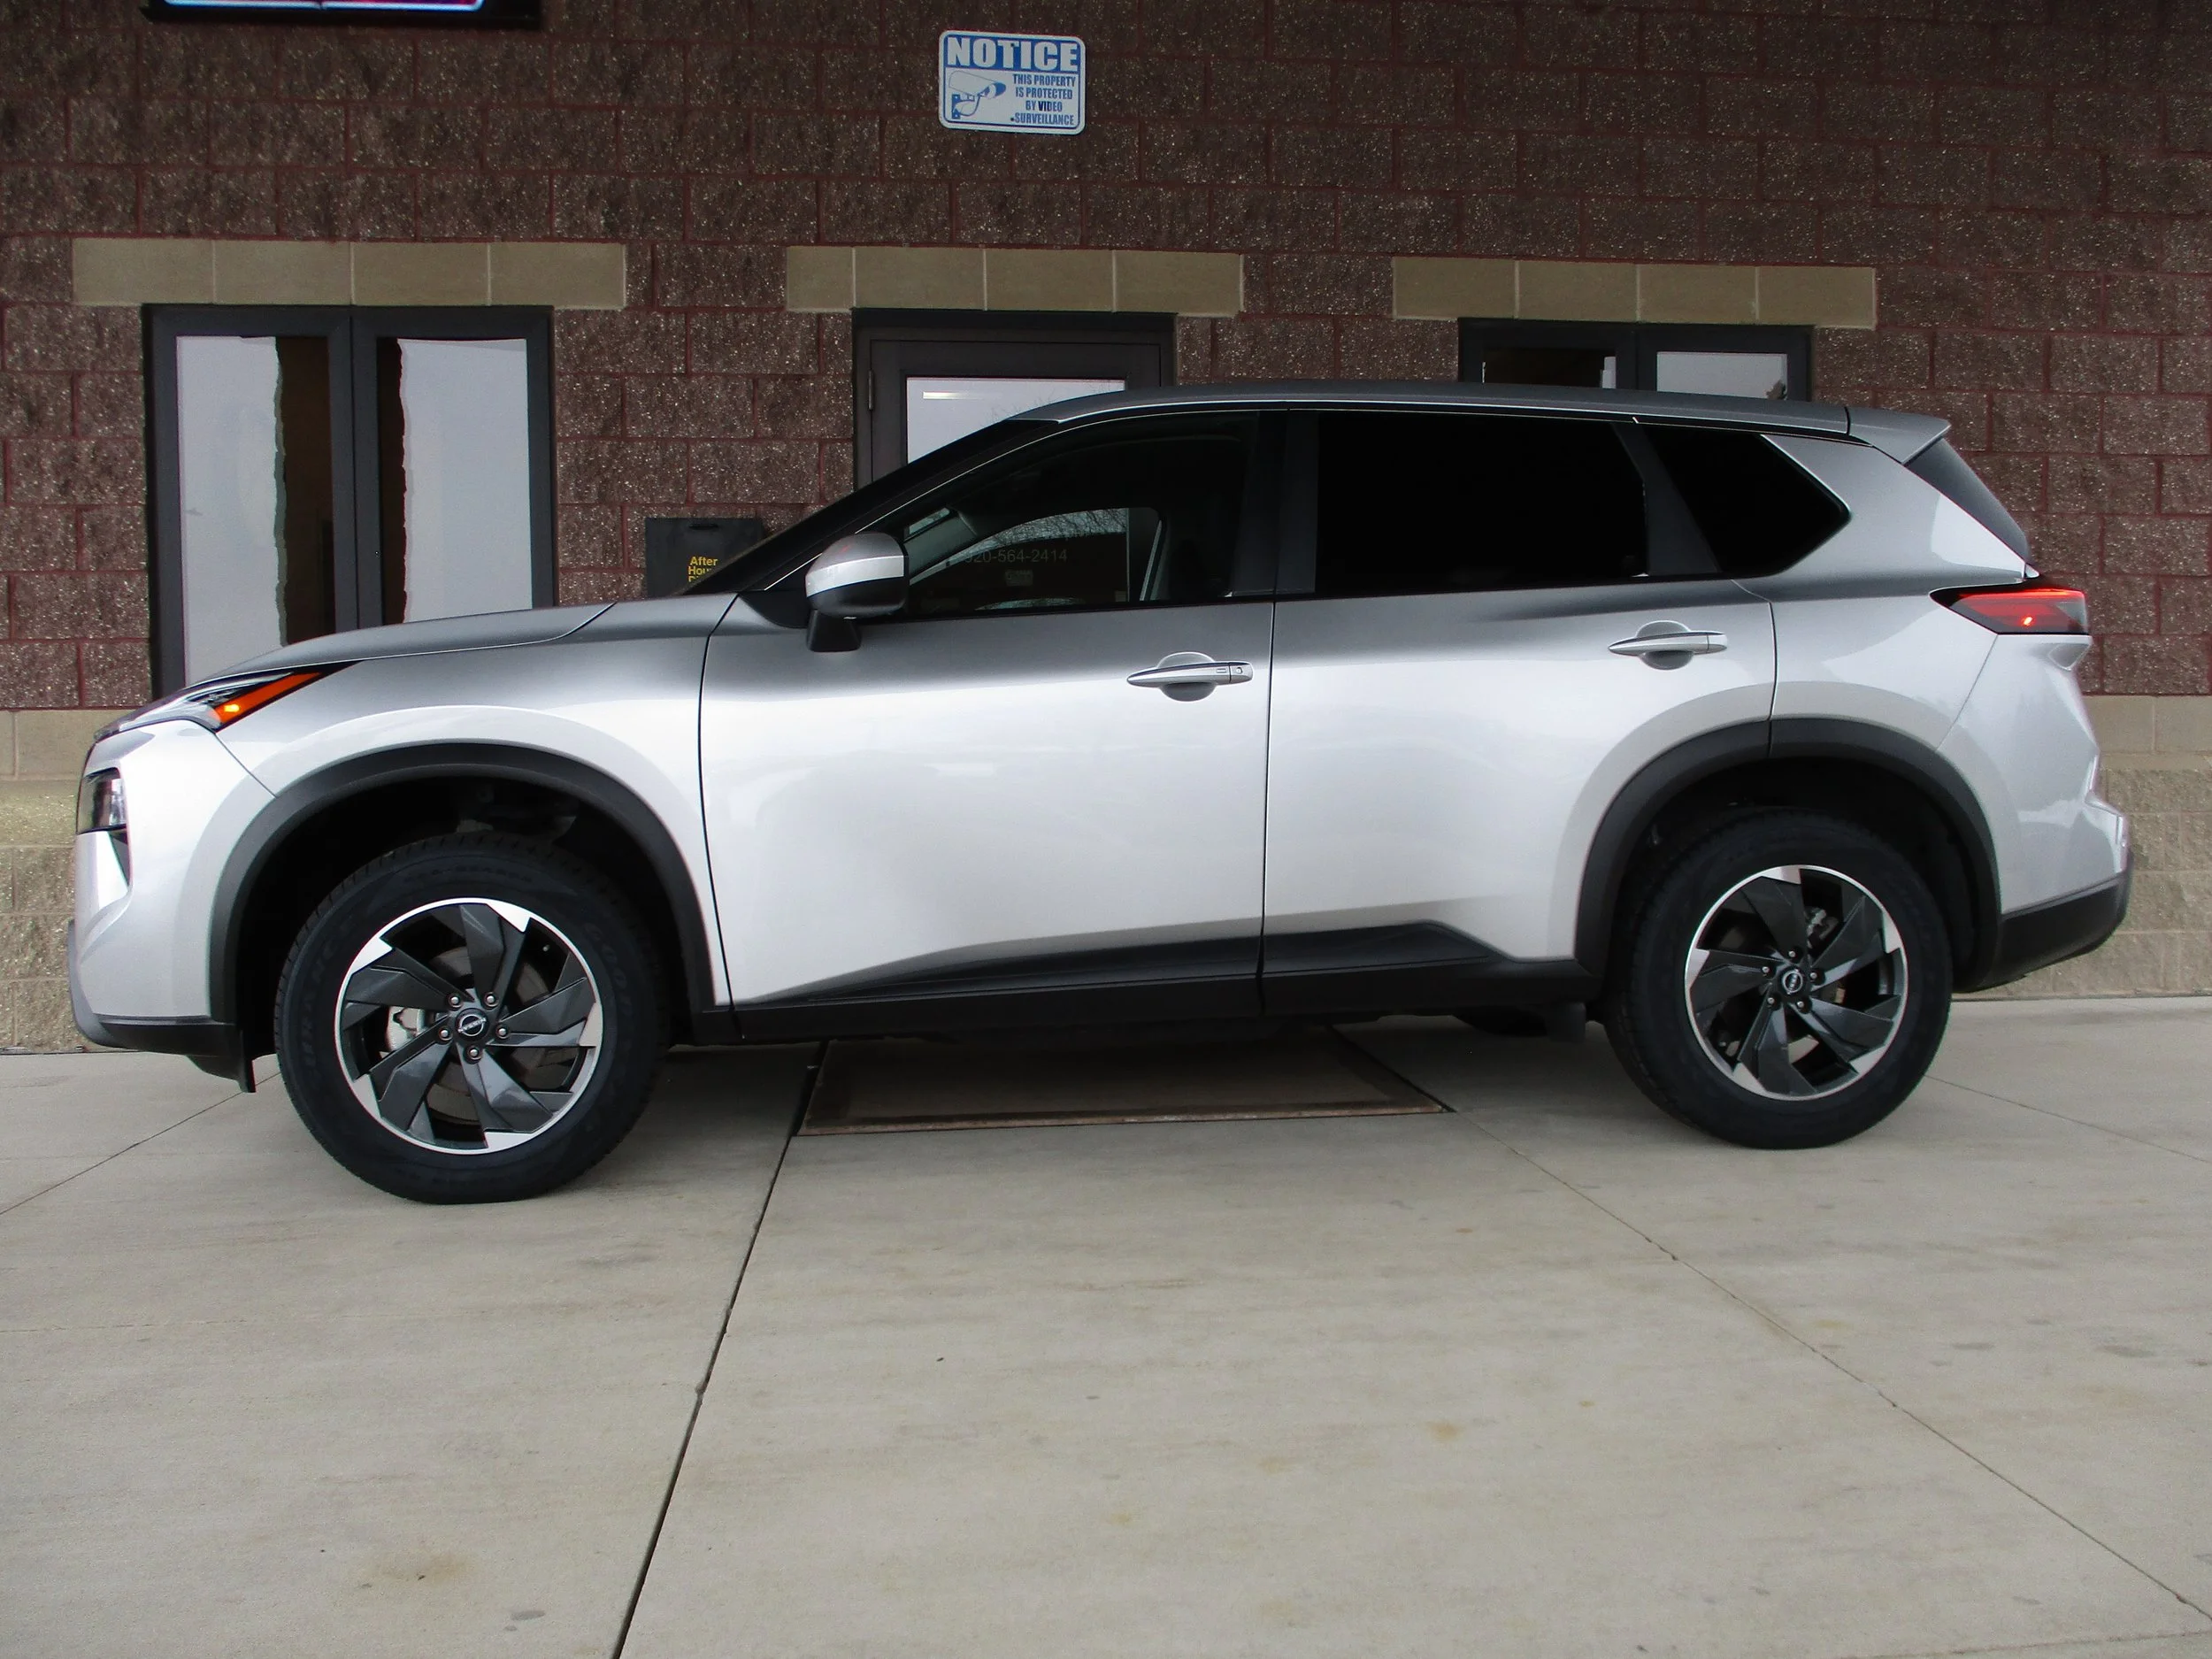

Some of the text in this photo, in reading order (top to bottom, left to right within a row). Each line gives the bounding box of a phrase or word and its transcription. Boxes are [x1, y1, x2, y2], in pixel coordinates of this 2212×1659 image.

[948, 36, 1079, 72] NOTICE
[1012, 73, 1076, 88] THIS PROPERTY
[1016, 87, 1072, 100] IS PROTECTED
[1025, 101, 1063, 112] BY VIDEO
[1014, 112, 1074, 126] SURVEILLANCE
[689, 556, 718, 565] After
